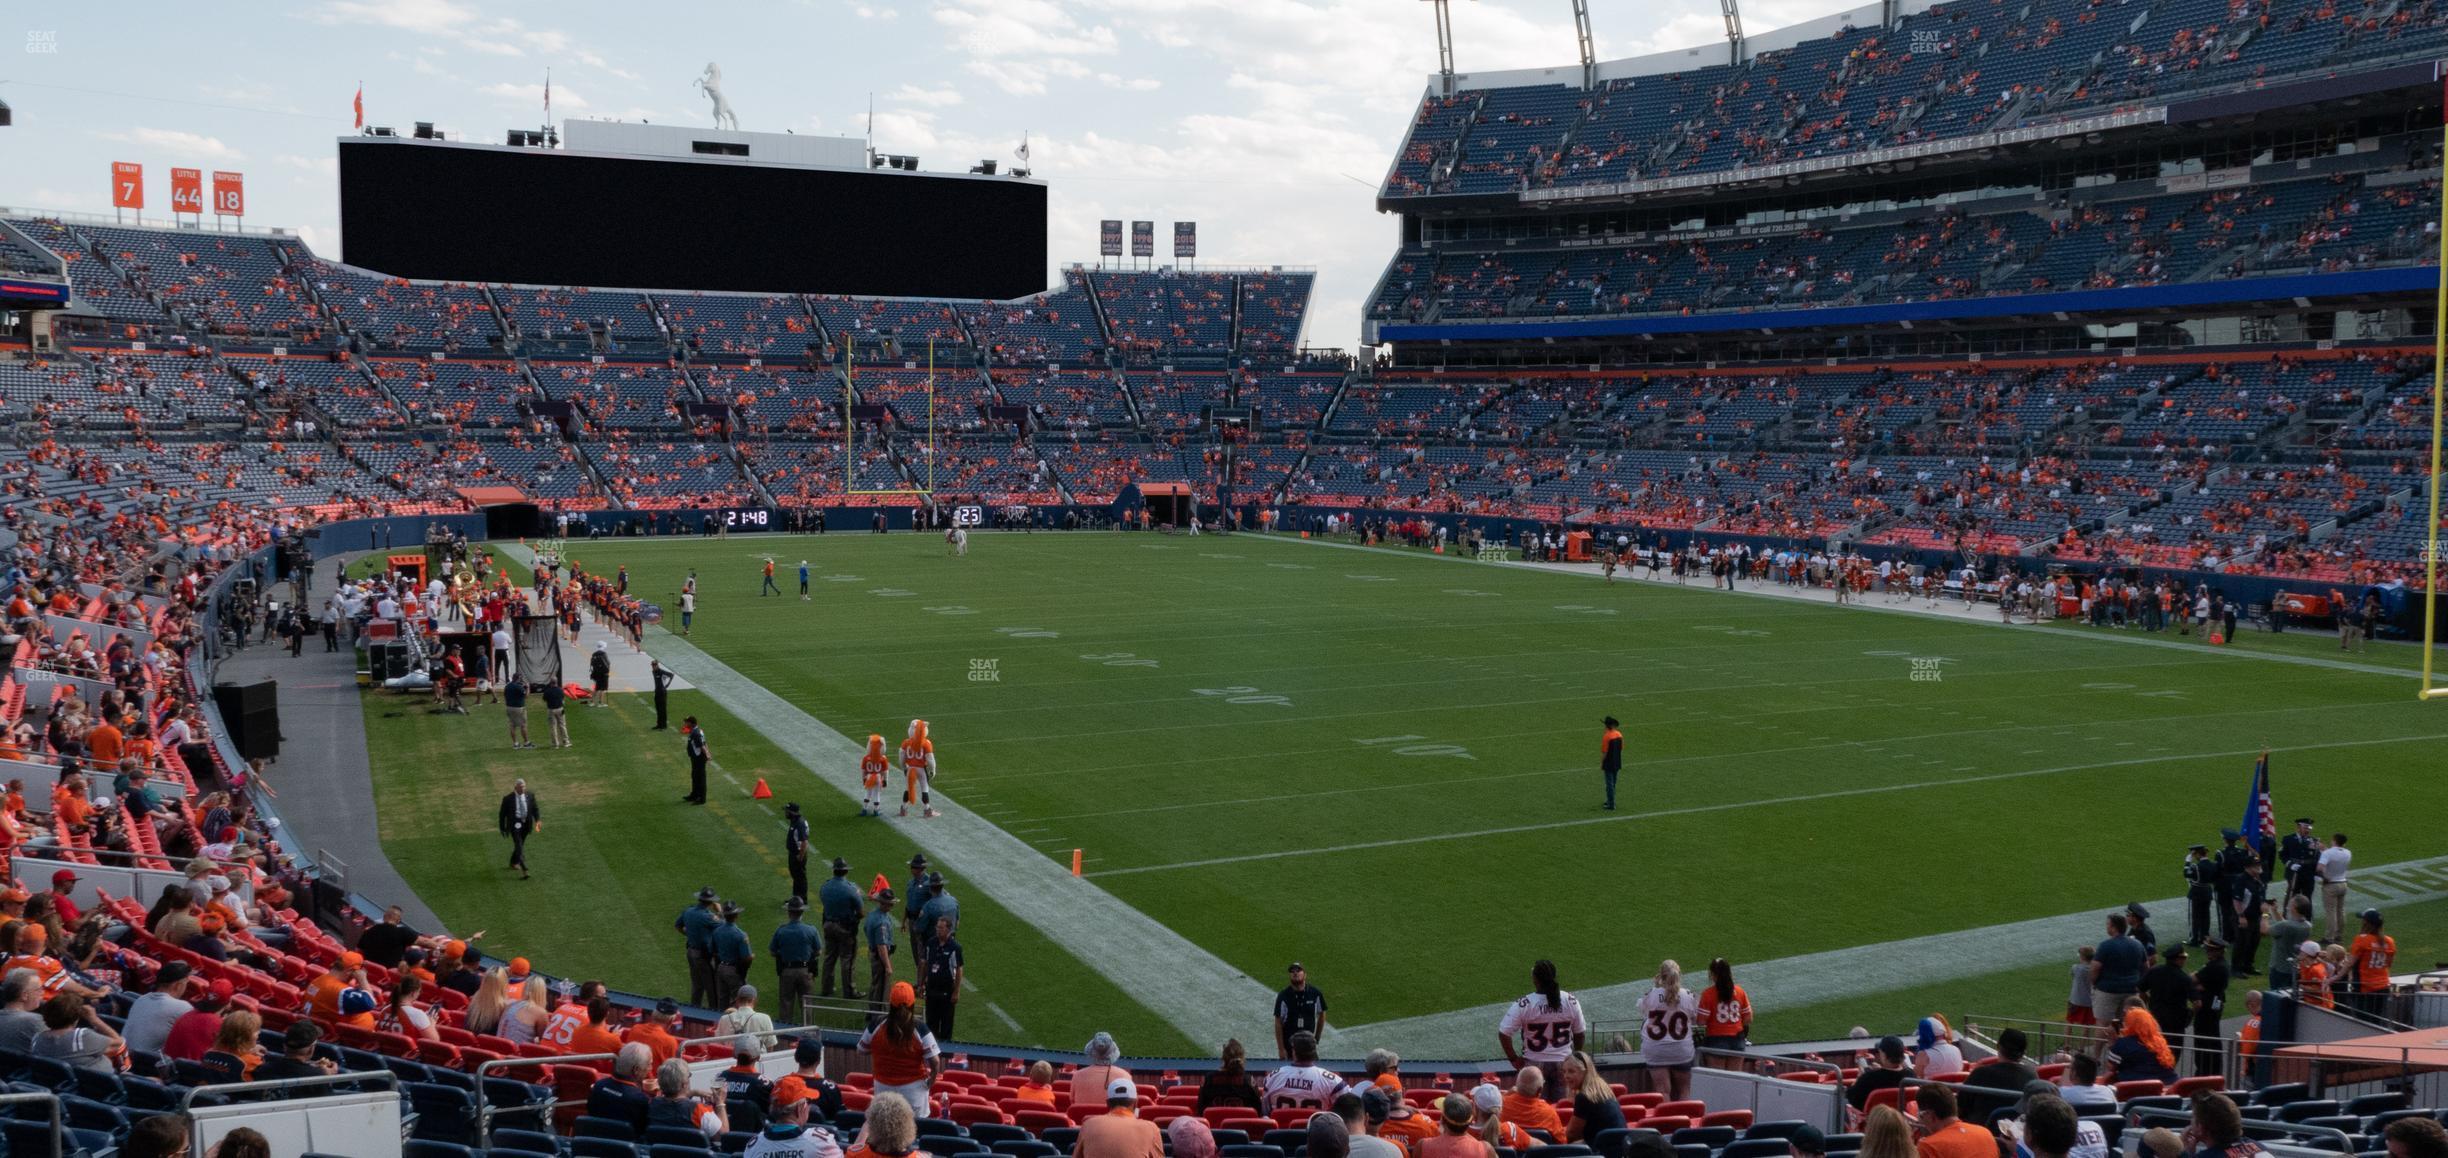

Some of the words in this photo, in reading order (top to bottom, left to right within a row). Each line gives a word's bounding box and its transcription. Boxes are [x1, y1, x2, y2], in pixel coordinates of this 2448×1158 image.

[177, 170, 196, 178] LITTLE
[122, 182, 135, 201] 7
[174, 187, 201, 207] 44
[219, 191, 240, 210] 18
[961, 508, 979, 522] 25
[866, 761, 882, 772] 00
[1717, 1001, 1740, 1023] 88
[543, 1014, 580, 1044] 25
[1647, 1010, 1689, 1040] 30
[1284, 1078, 1313, 1091] ALLEN
[763, 1150, 804, 1158] SANDERS
